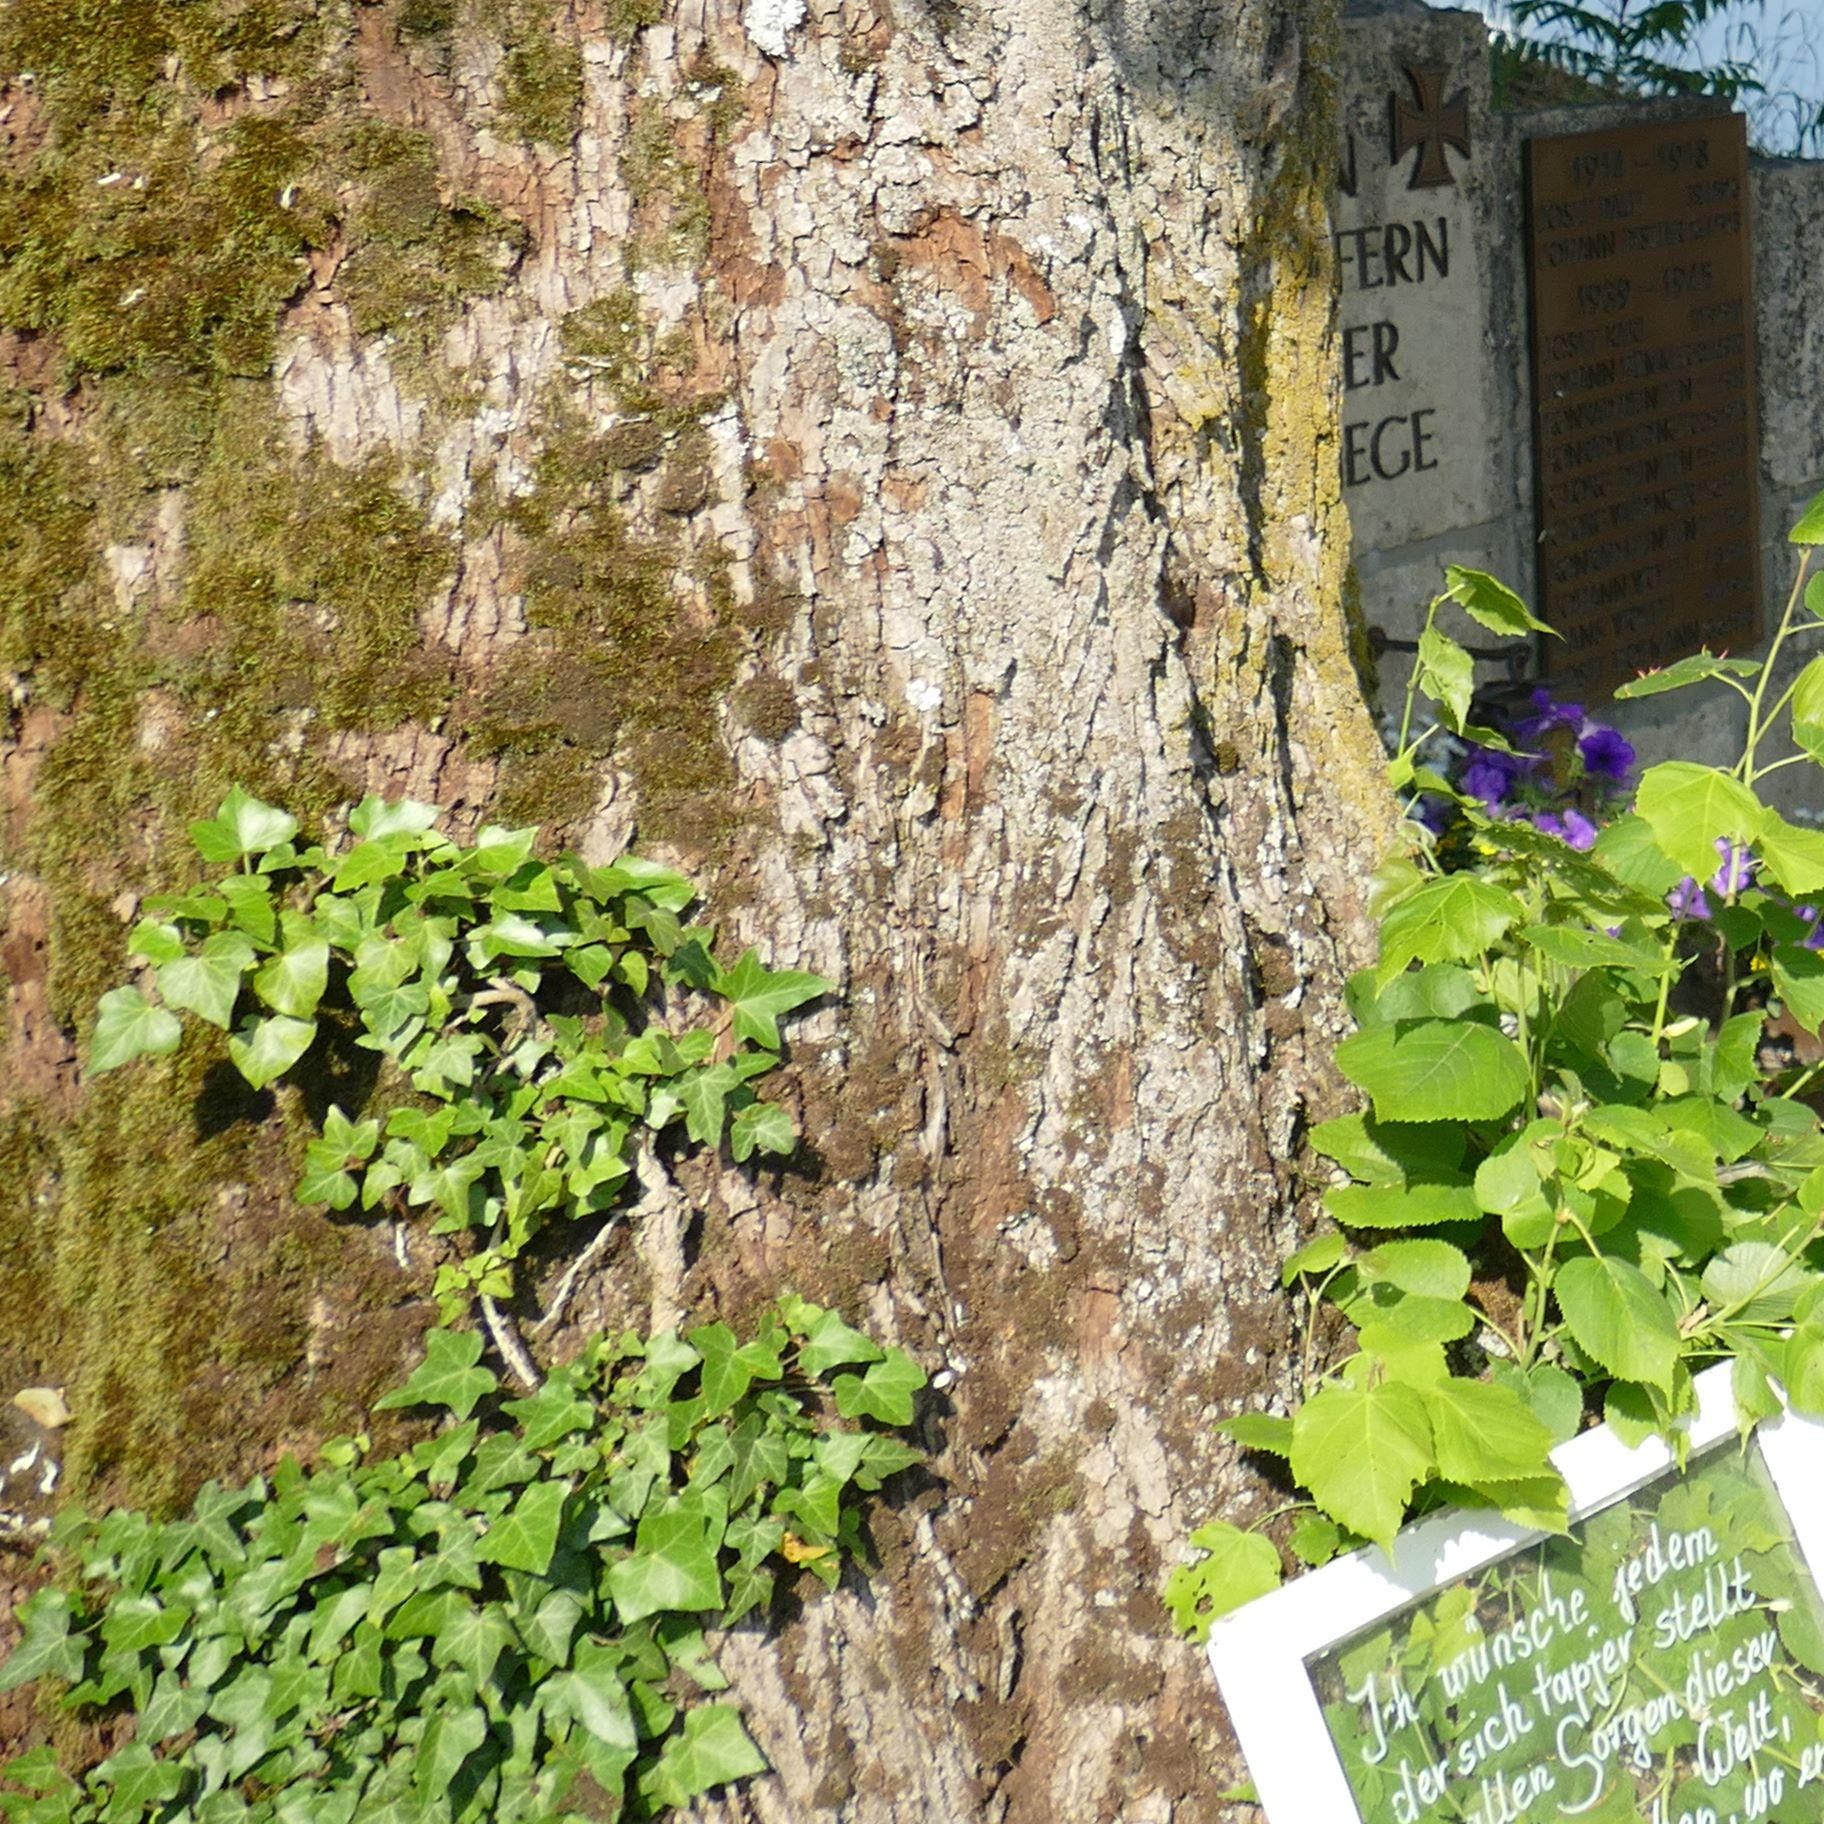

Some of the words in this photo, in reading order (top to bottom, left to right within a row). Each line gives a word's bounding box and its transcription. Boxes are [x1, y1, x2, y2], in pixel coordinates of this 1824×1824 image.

[1335, 216, 1449, 295] FERN
[1343, 321, 1400, 391] ER
[1345, 408, 1438, 488] EGE
[1347, 1669, 1421, 1764] Ich
[1437, 1568, 1589, 1700] wünsche
[1612, 1522, 1719, 1626] jedem
[1391, 1758, 1450, 1824] der
[1457, 1683, 1536, 1776] sich
[1533, 1624, 1634, 1723] tapfer
[1654, 1556, 1757, 1649] stellt
[1556, 1691, 1685, 1816] Sorgen
[1686, 1630, 1778, 1713] dieser
[1697, 1688, 1792, 1788] Welt,
